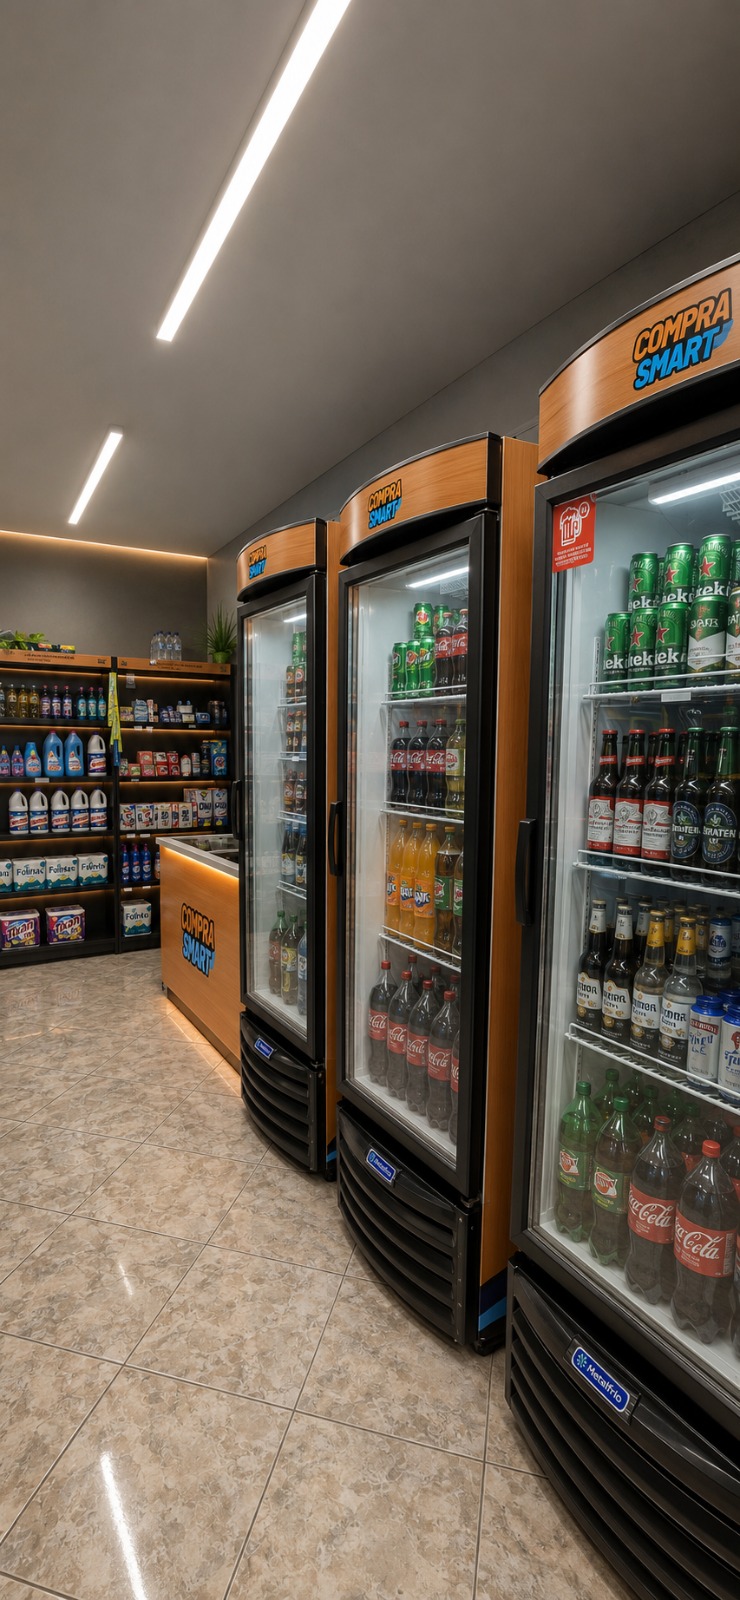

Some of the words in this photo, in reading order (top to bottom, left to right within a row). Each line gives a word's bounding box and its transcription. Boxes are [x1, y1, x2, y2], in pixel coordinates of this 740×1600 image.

[633, 289, 731, 362] COMPRA
[635, 326, 721, 390] SMART
[368, 479, 402, 511] COMPRA
[369, 502, 398, 528] SMART
[181, 903, 215, 950] COMPRA
[183, 932, 212, 977] SMART
